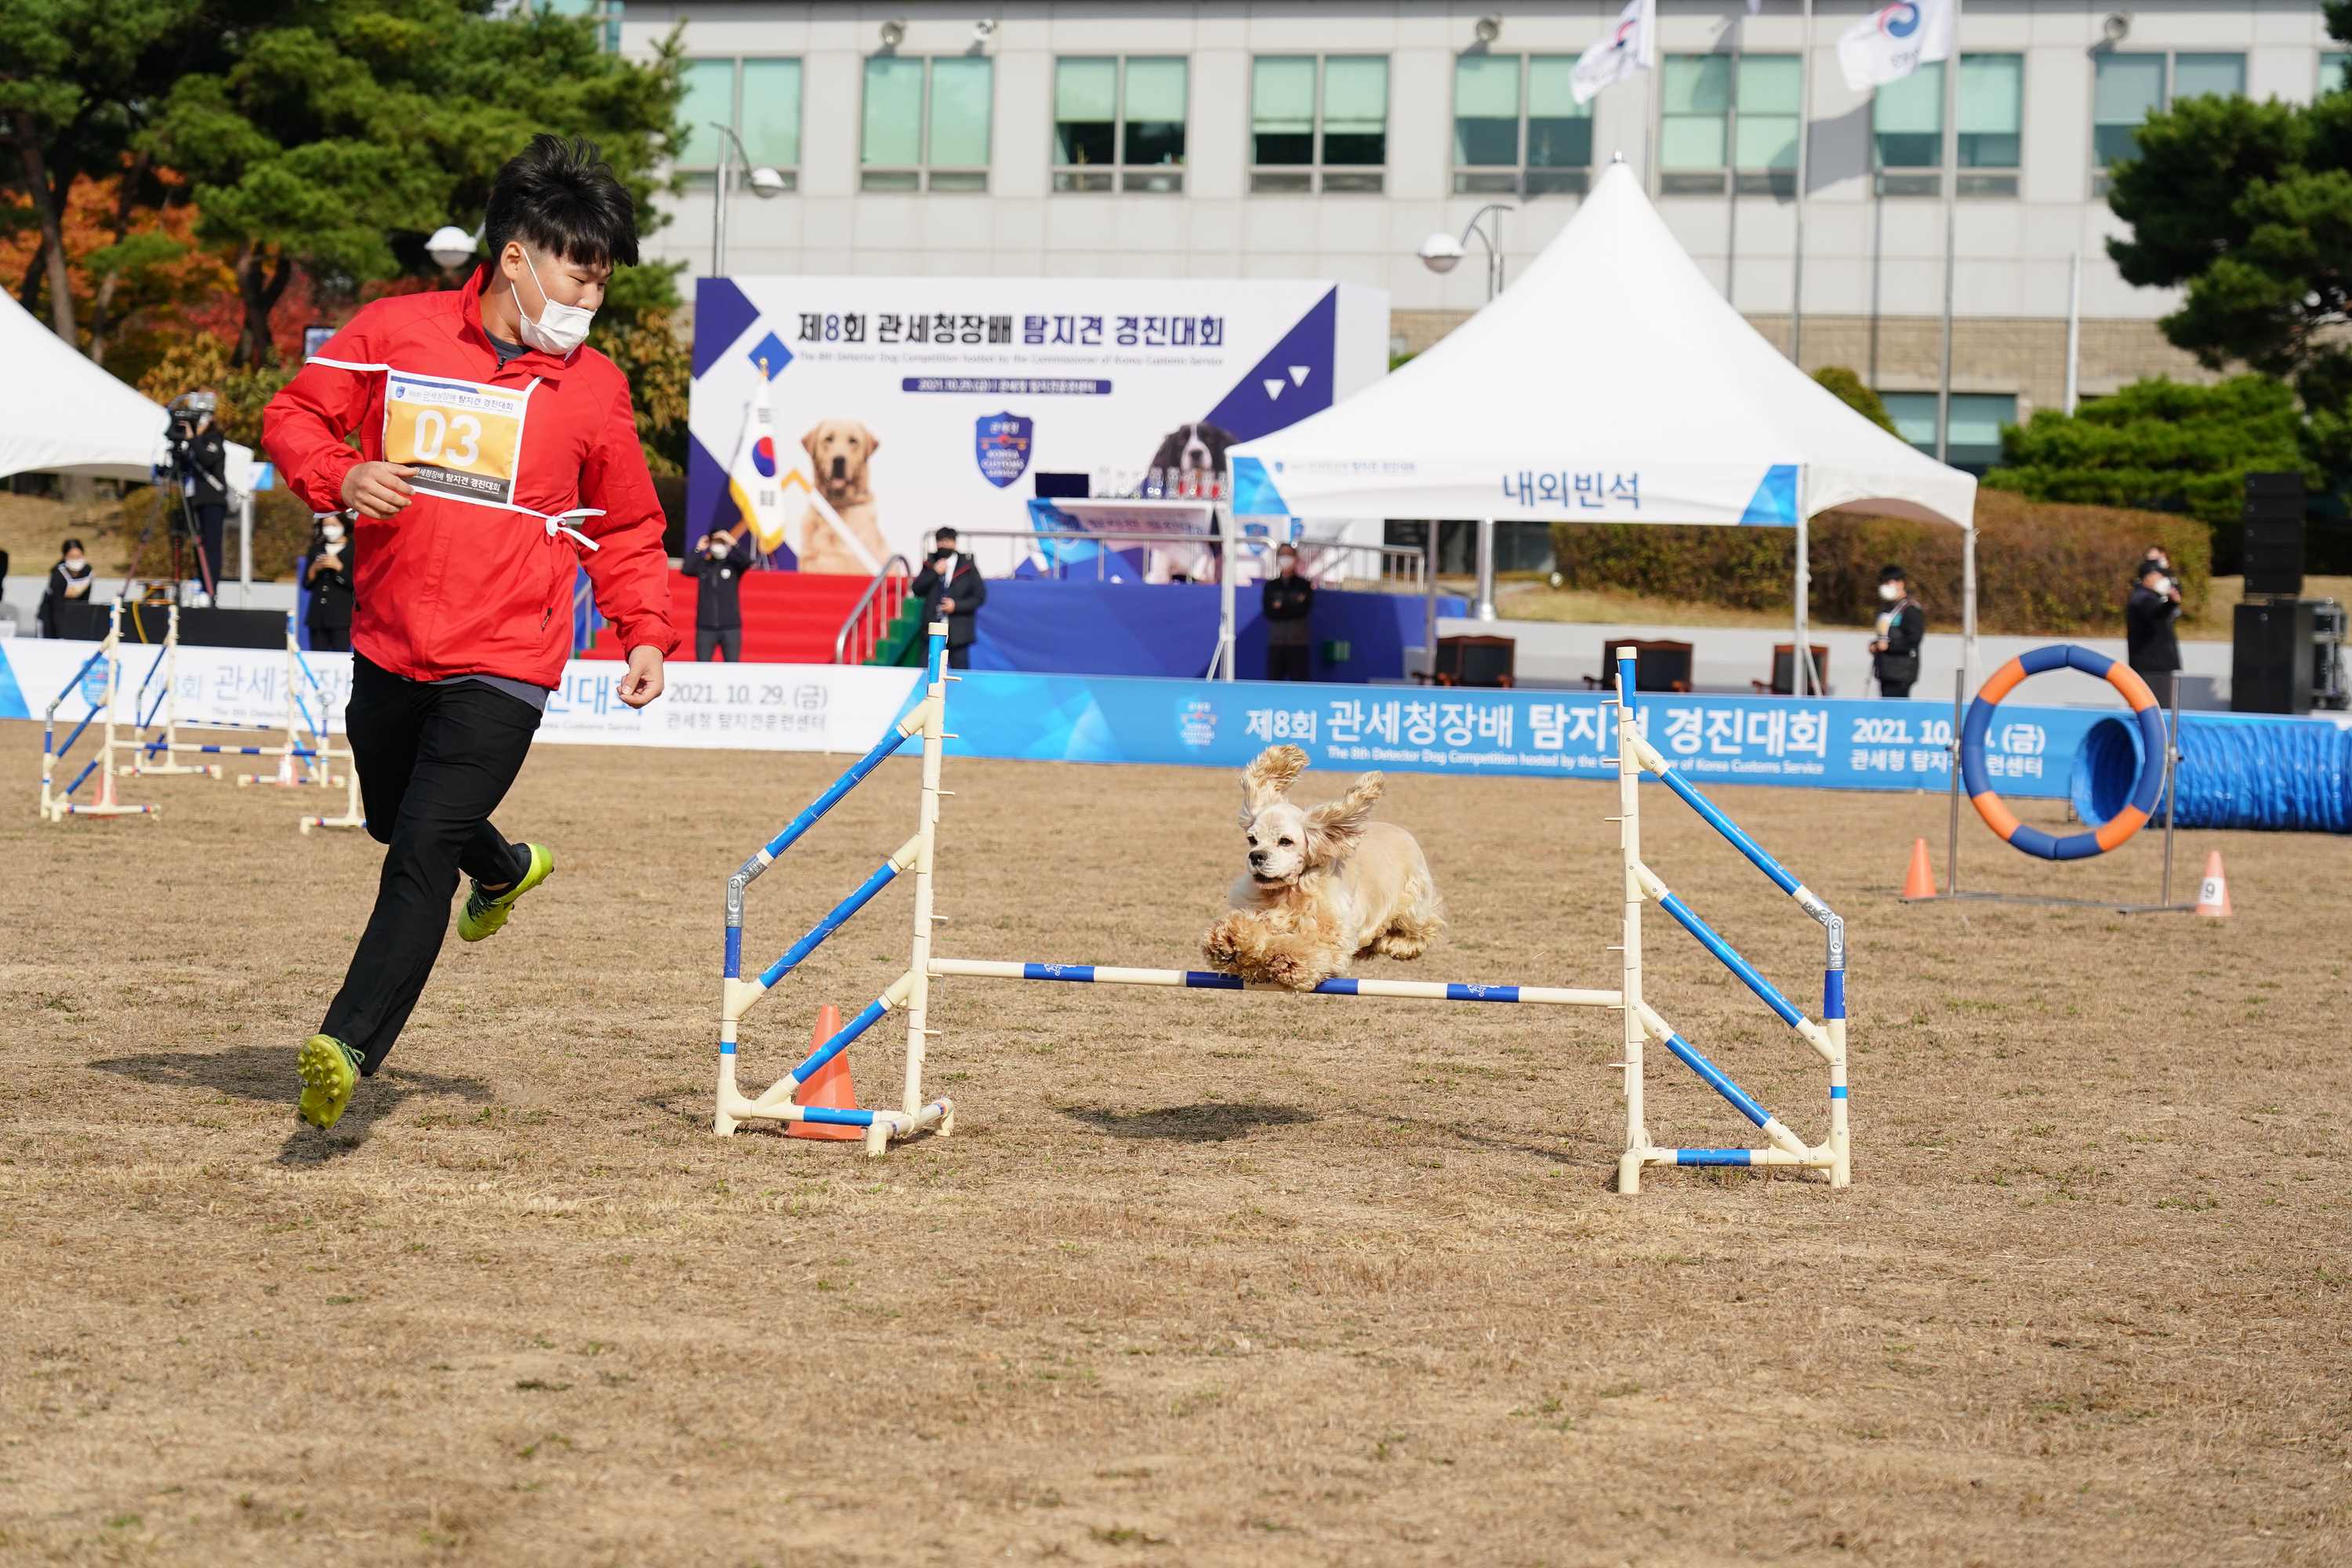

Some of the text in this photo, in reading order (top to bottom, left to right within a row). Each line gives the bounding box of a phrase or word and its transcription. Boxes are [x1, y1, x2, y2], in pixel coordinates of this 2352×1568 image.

[798, 313, 1223, 346] 제8회 관세청장배 탐지견 경진대회
[1190, 356, 1223, 365] Service
[458, 394, 481, 405] 탐지견
[483, 398, 514, 411] 경진대회
[413, 408, 483, 467] 03
[445, 473, 469, 486] 탐지견
[470, 477, 501, 492] 경진대회
[1503, 470, 1639, 510] 내외빈석
[668, 683, 829, 710] 2021. 10. 29. (금)
[1245, 708, 1318, 744] 제8회
[1326, 699, 1514, 749] 관세청장배
[1663, 706, 1829, 759] 경진대회
[1850, 717, 1915, 745] 2021.
[2002, 723, 2046, 755] (금)
[1326, 746, 1349, 760] The
[1351, 746, 1370, 760] 8th
[1374, 746, 1421, 761] Detector
[1422, 749, 1447, 765] Dog
[1449, 749, 1519, 765] Competition
[1519, 751, 1559, 767] hosted
[1562, 753, 1576, 770] by
[1577, 754, 1598, 767] the
[1679, 757, 1694, 771] of
[1696, 758, 1730, 772] Korea
[1730, 758, 1782, 773] Customs
[1782, 760, 1825, 775] Service
[2205, 881, 2216, 899] 9
